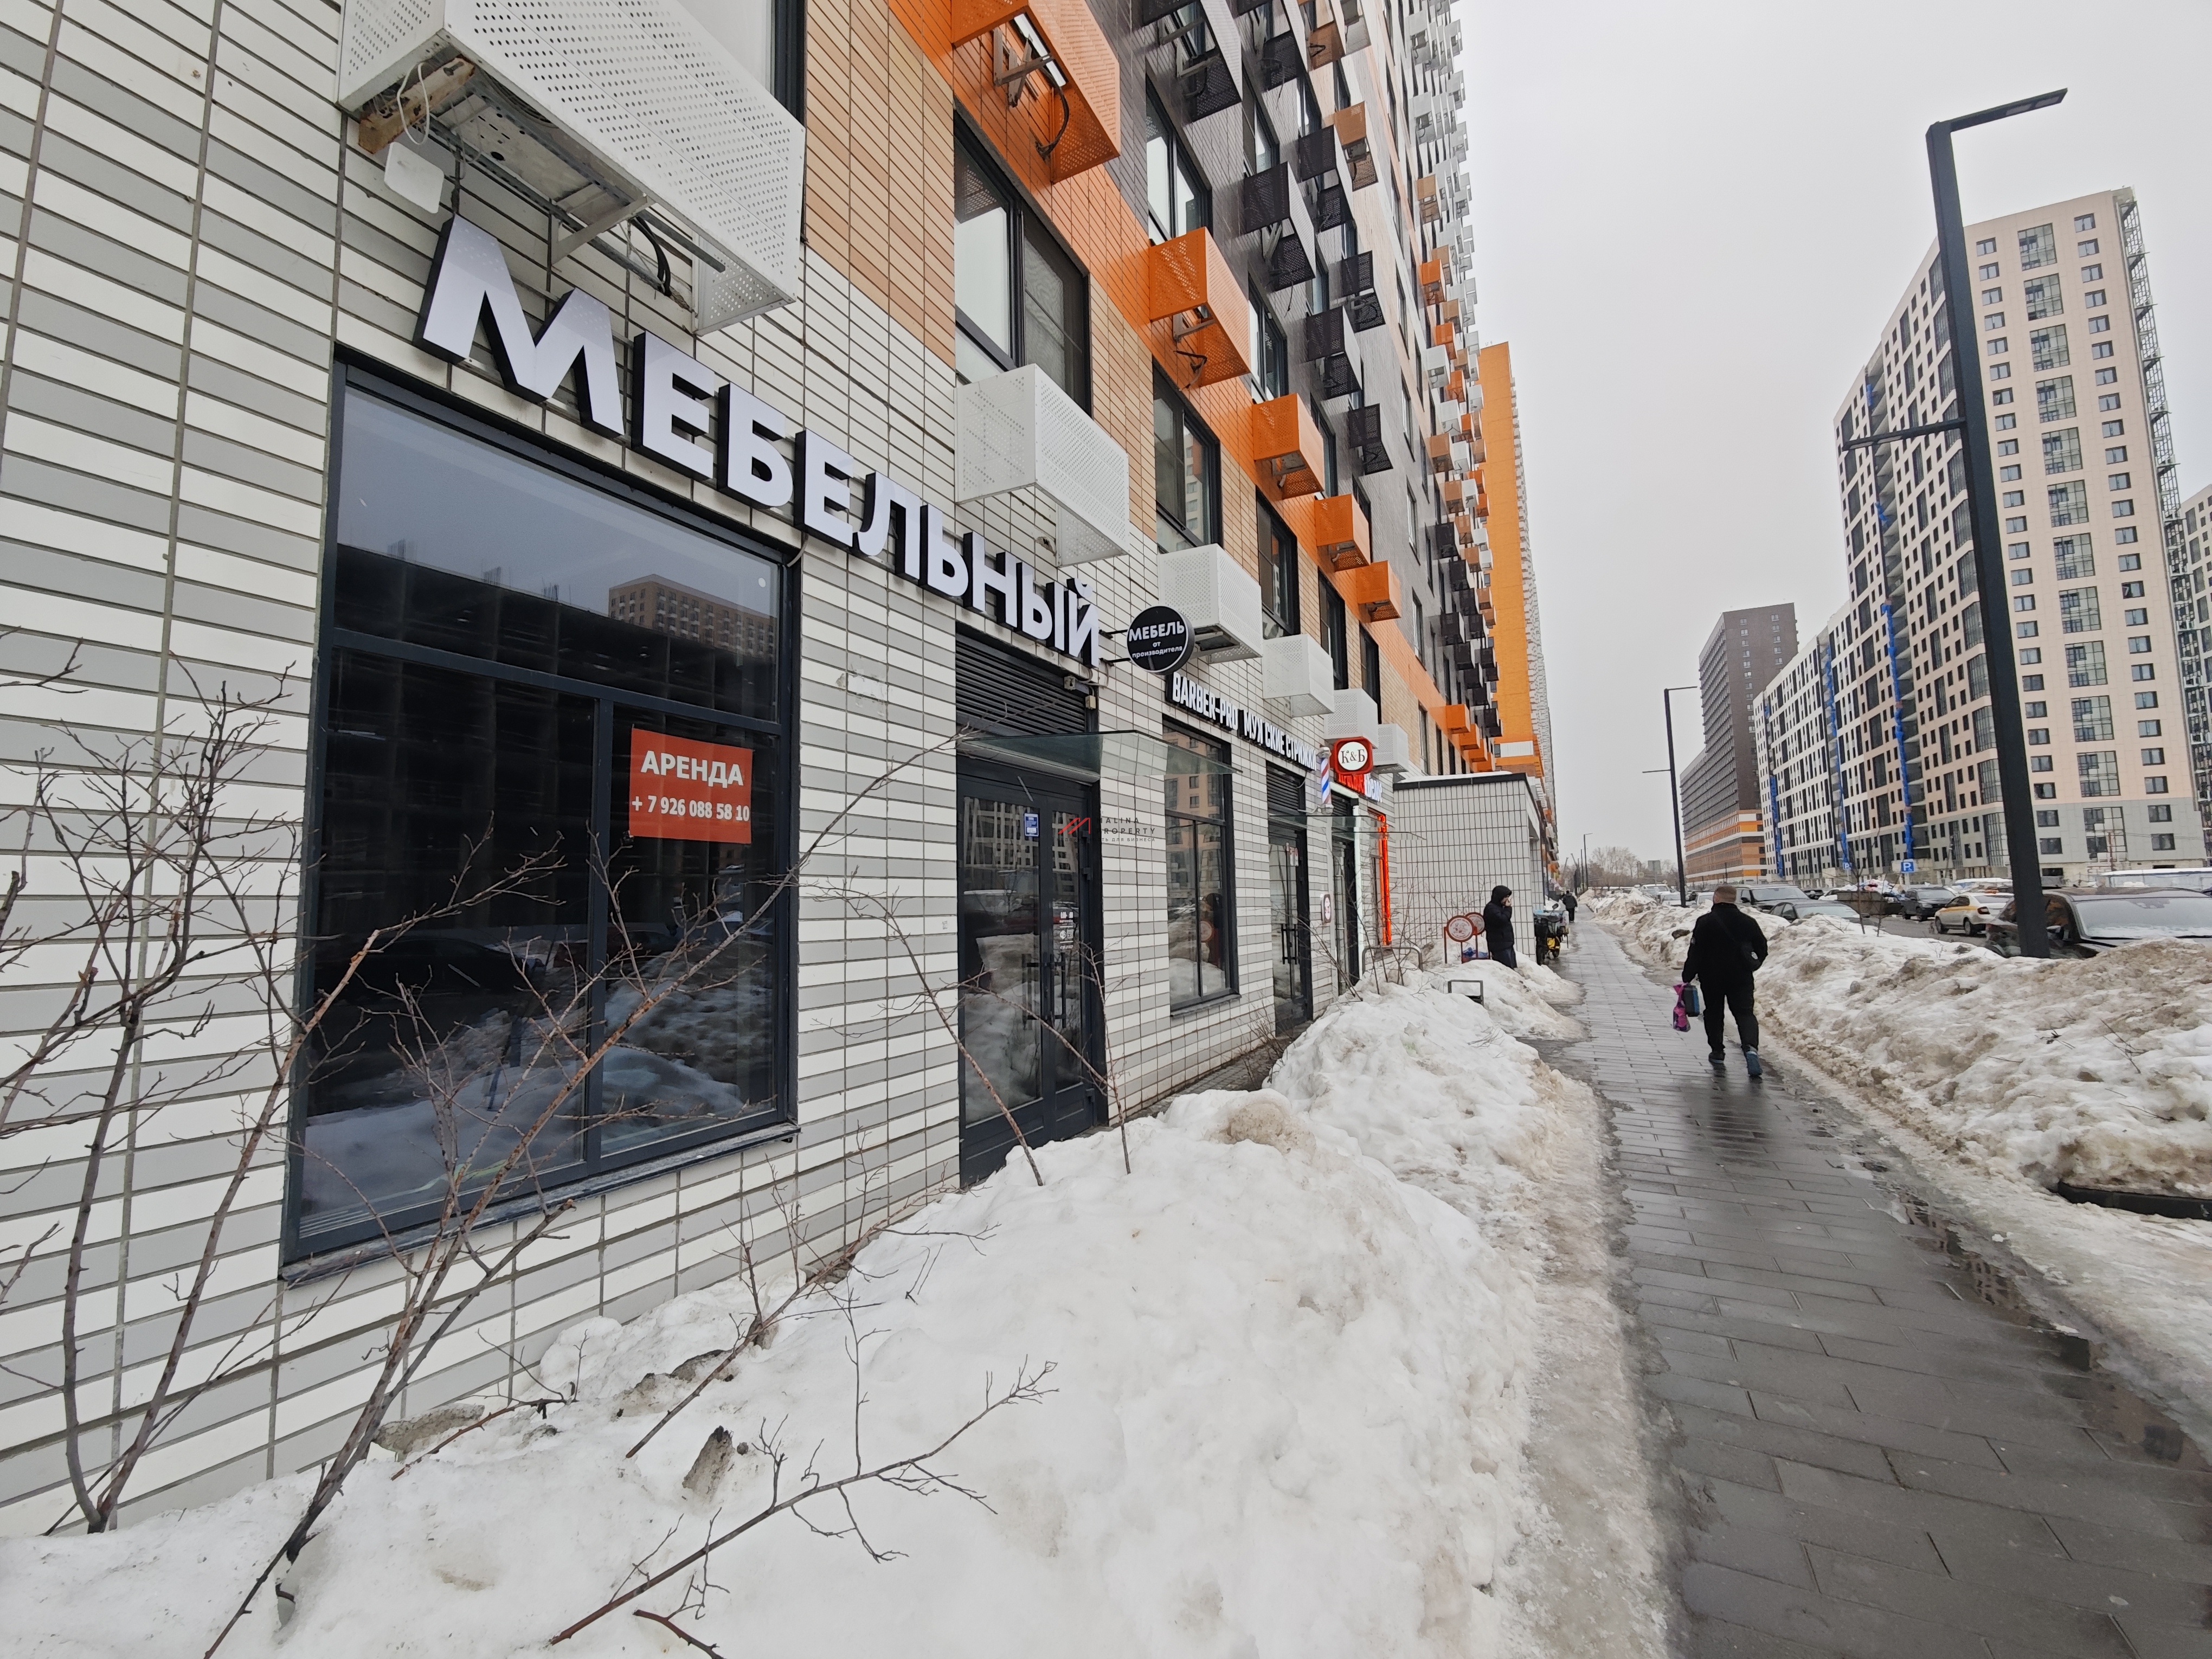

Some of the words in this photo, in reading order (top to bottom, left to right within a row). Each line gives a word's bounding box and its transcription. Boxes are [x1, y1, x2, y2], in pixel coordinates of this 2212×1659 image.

[416, 216, 1099, 668] МЕБЕЛЬНЫЙ
[1128, 621, 1185, 642] МЕБЕЛЬ
[1132, 646, 1183, 659] производителя
[1172, 671, 1238, 730] BARBER-PRO
[1285, 735, 1317, 771] СТРИЖКИ
[640, 750, 744, 788] АРЕНДА
[647, 795, 657, 813] 7
[660, 796, 686, 816] 926
[689, 800, 712, 819] 088
[716, 803, 732, 820] 58
[736, 805, 750, 821] 10
